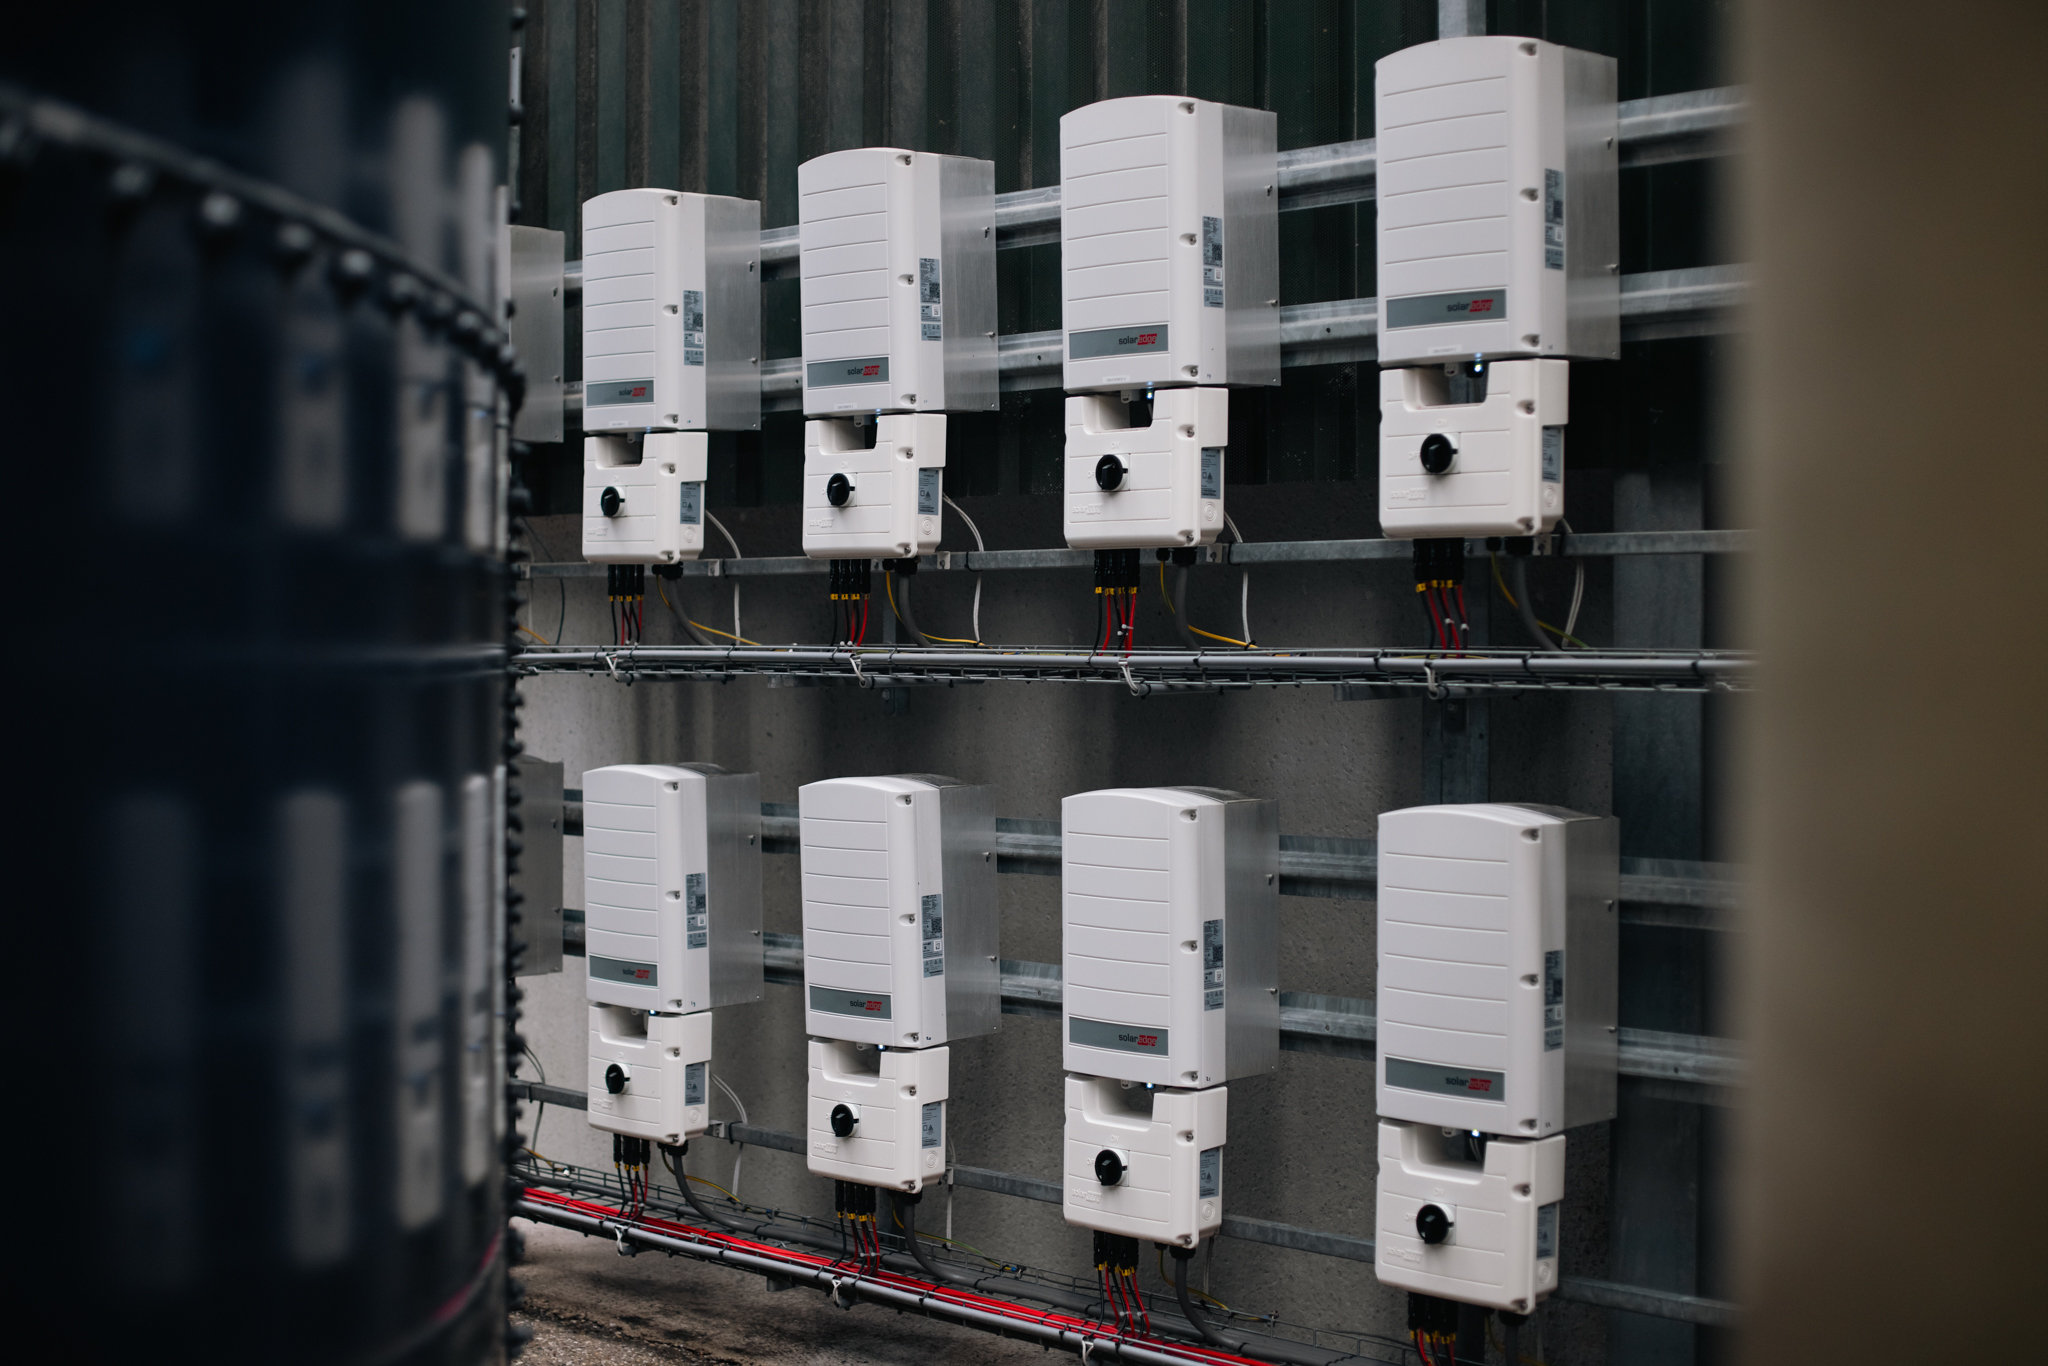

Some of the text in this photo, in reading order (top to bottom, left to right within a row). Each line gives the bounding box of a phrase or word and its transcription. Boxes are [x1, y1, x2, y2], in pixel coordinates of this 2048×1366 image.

[1118, 333, 1158, 345] solaredge
[847, 365, 880, 376] solaredge
[849, 999, 882, 1011] solaredge
[1118, 1033, 1158, 1047] solaredge
